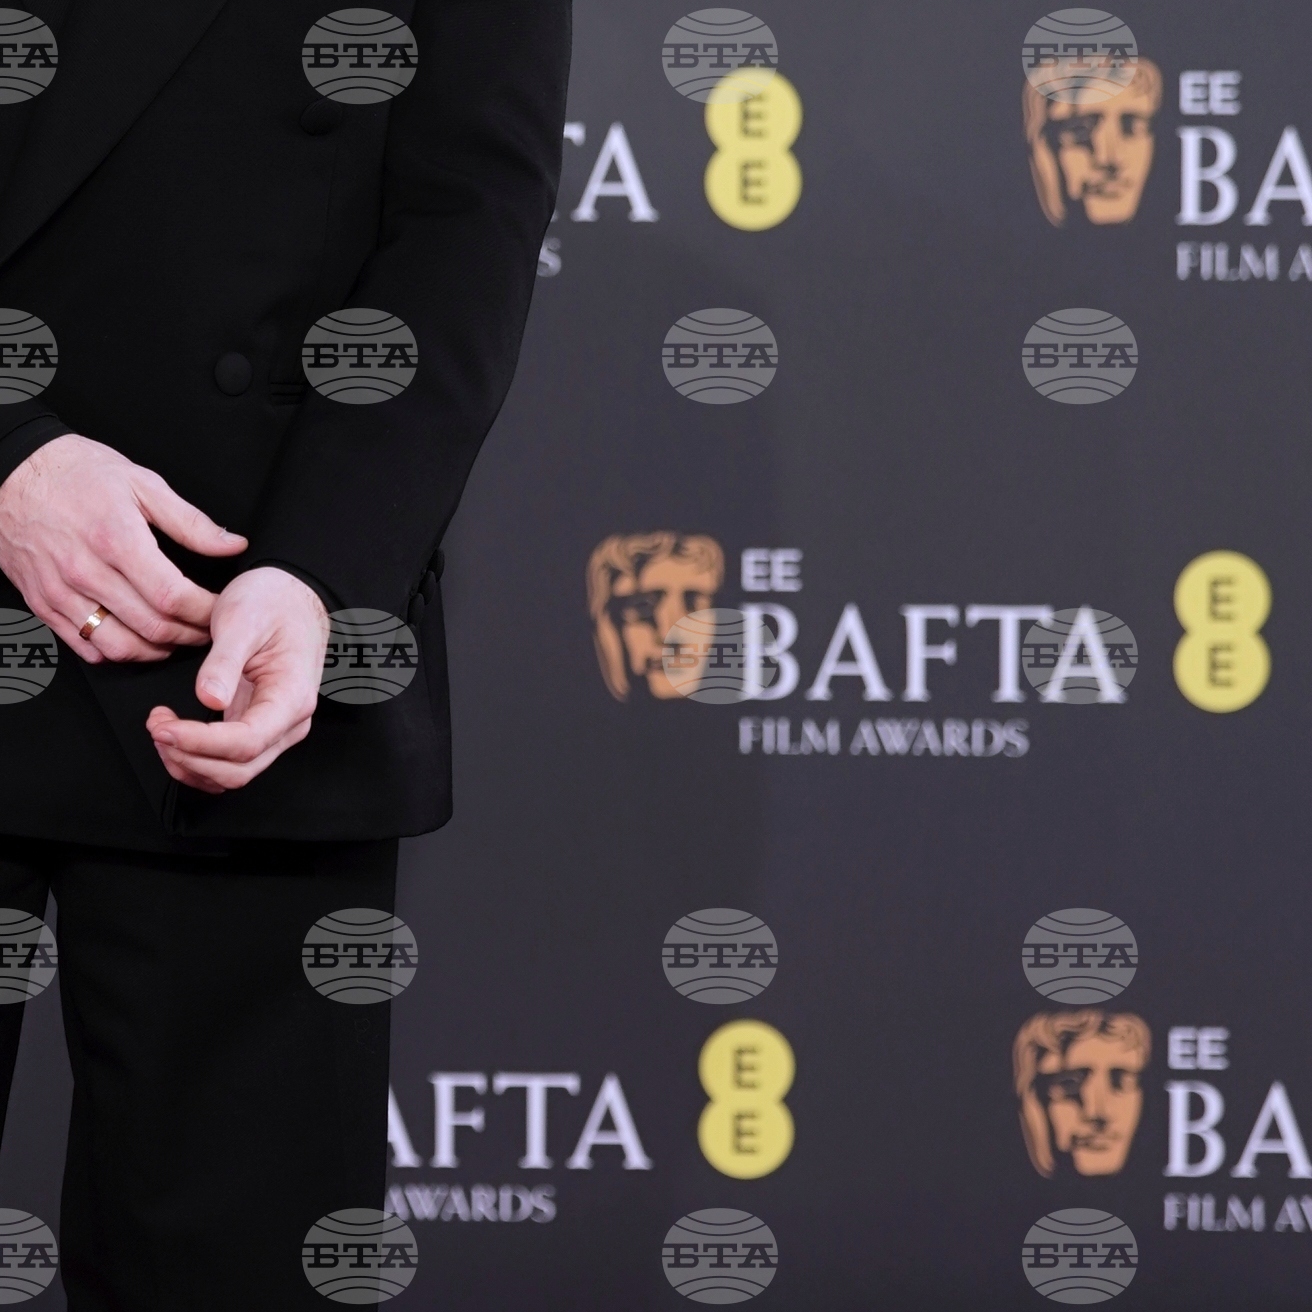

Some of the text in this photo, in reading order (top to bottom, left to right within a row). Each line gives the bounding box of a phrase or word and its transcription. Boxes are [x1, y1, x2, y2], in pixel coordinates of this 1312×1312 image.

[1179, 70, 1242, 115] EE
[1176, 241, 1280, 281] FILM
[741, 547, 802, 592] EE
[739, 602, 1127, 704] BAFTA
[738, 717, 1030, 758] FILM AWARDS
[1167, 1026, 1231, 1071] EE
[385, 1183, 557, 1224] AWARDS
[1164, 1192, 1266, 1232] FILM
